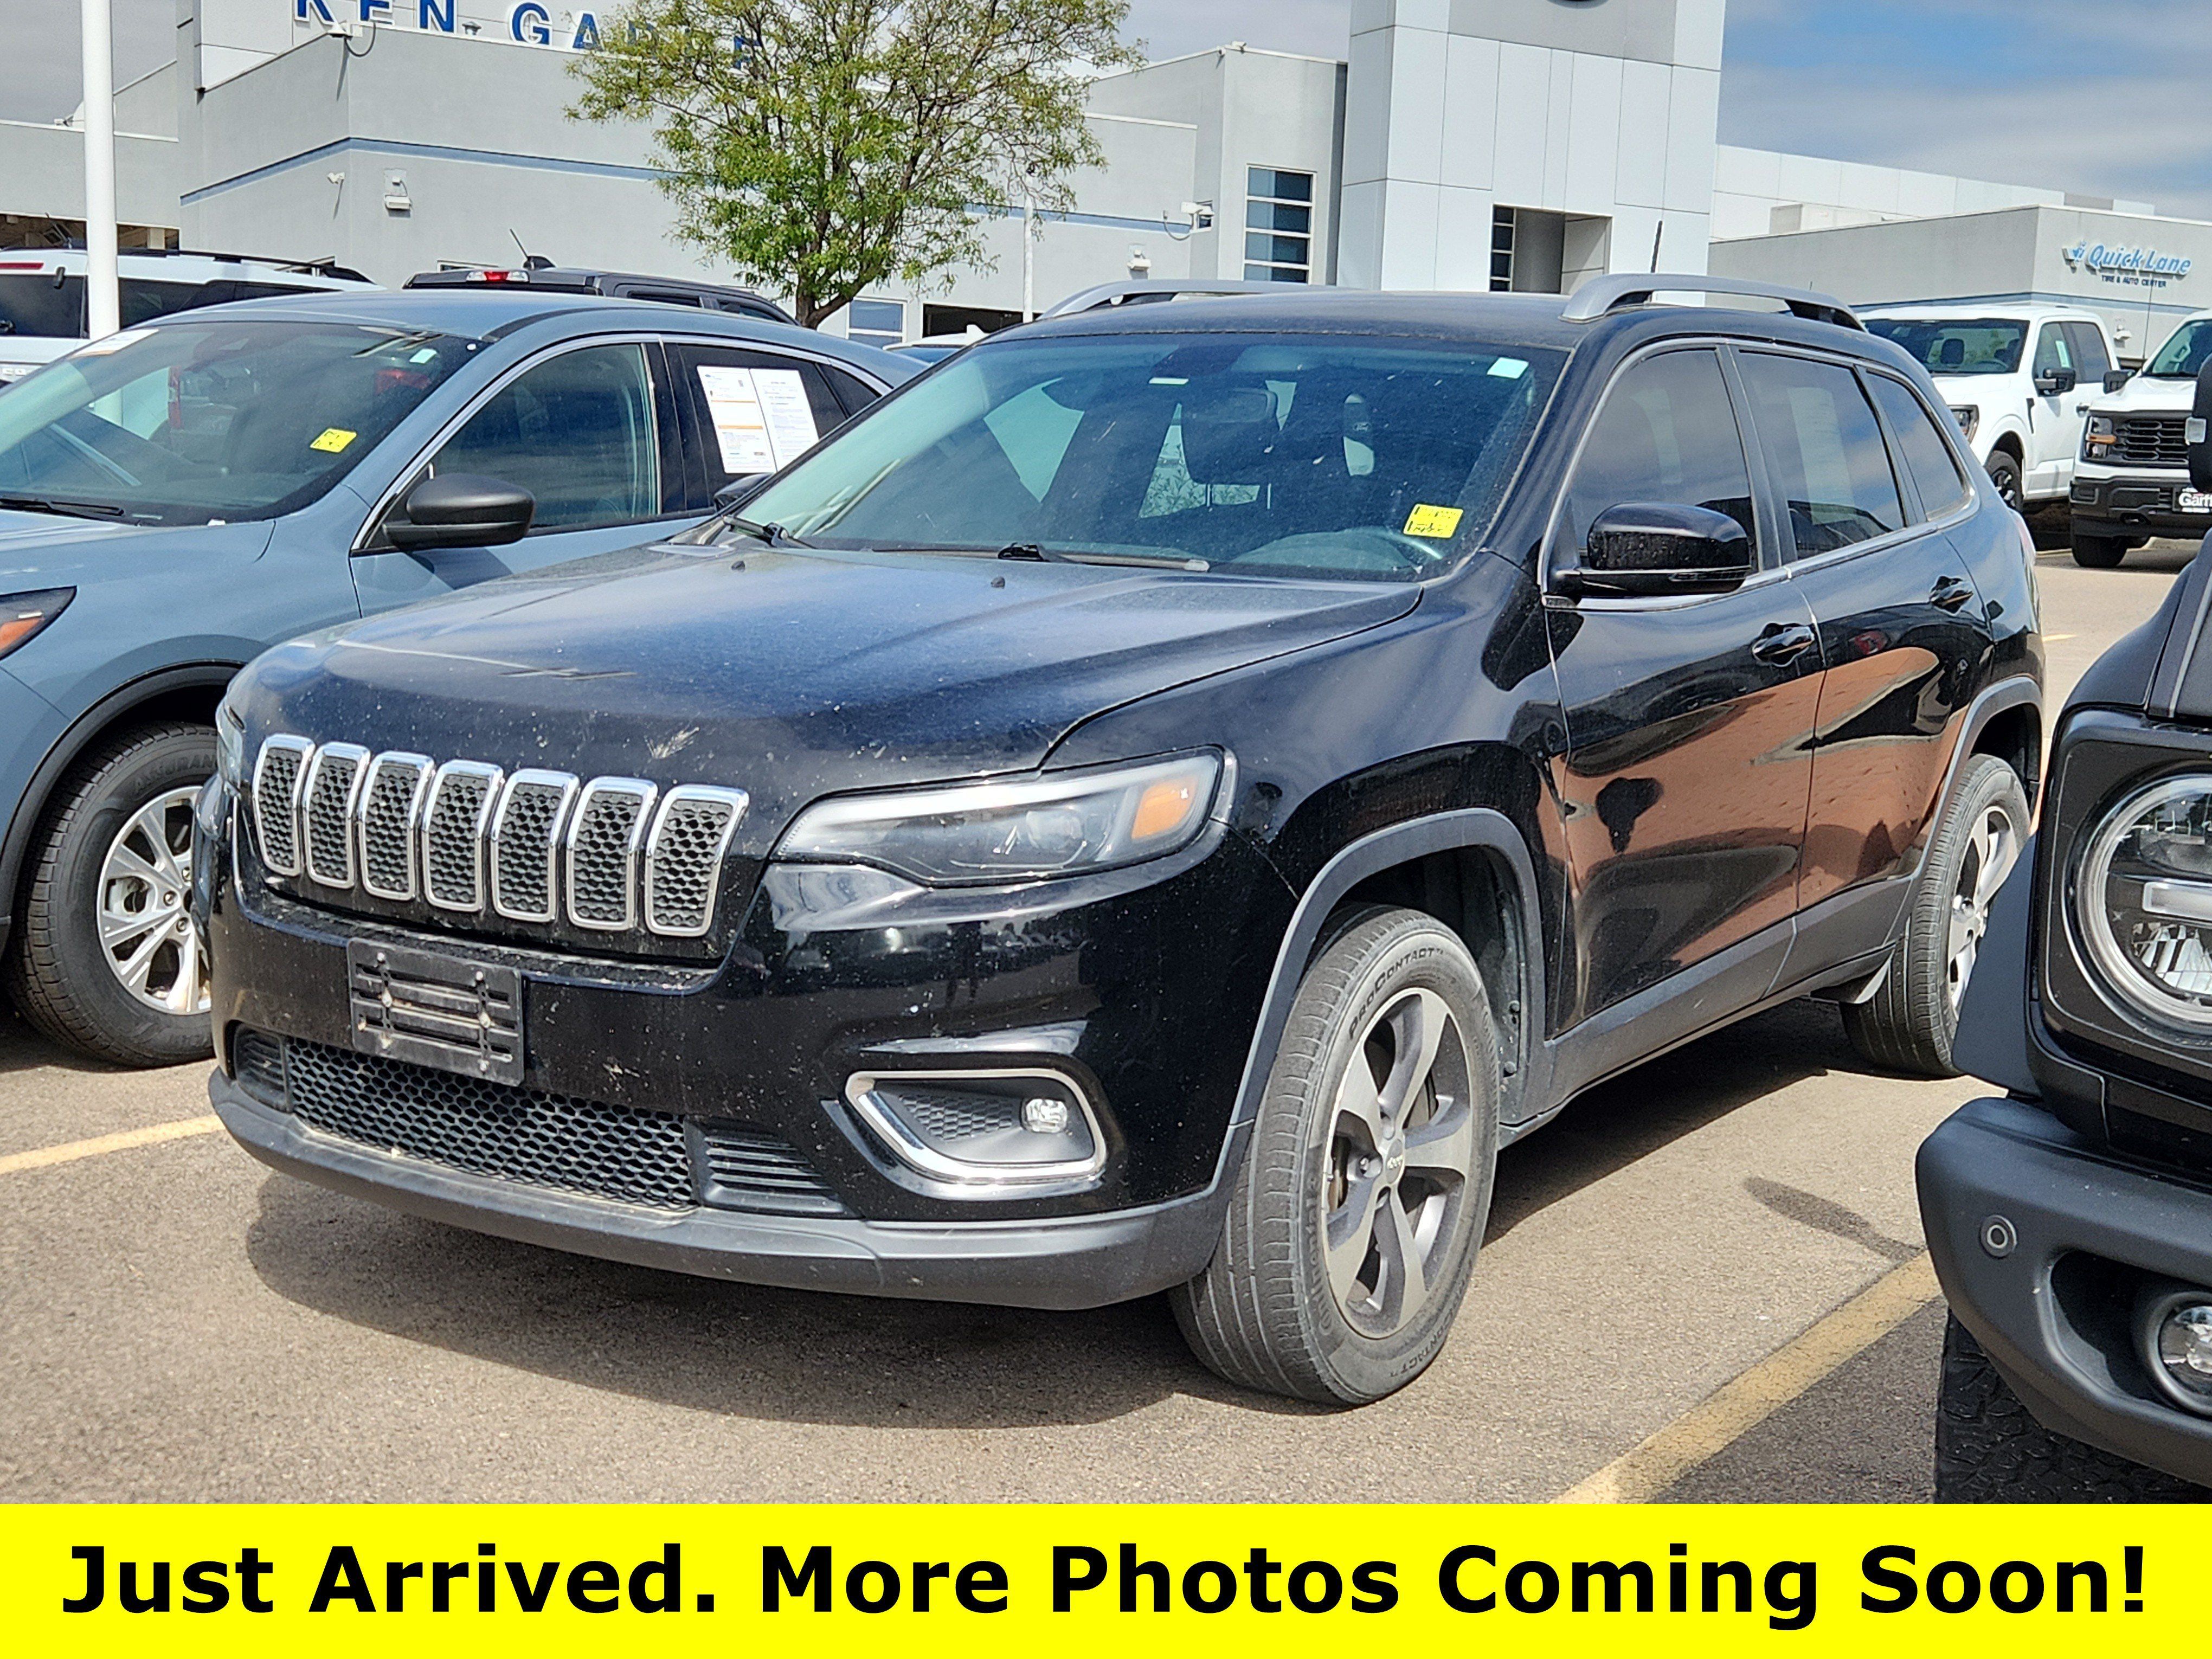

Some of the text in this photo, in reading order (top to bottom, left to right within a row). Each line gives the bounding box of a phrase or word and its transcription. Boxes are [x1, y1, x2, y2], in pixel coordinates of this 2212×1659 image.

[295, 0, 457, 33] KEN
[2089, 244, 2191, 273] Quick Lane
[2123, 276, 2139, 285] AUTO
[2141, 279, 2166, 288] CENTER
